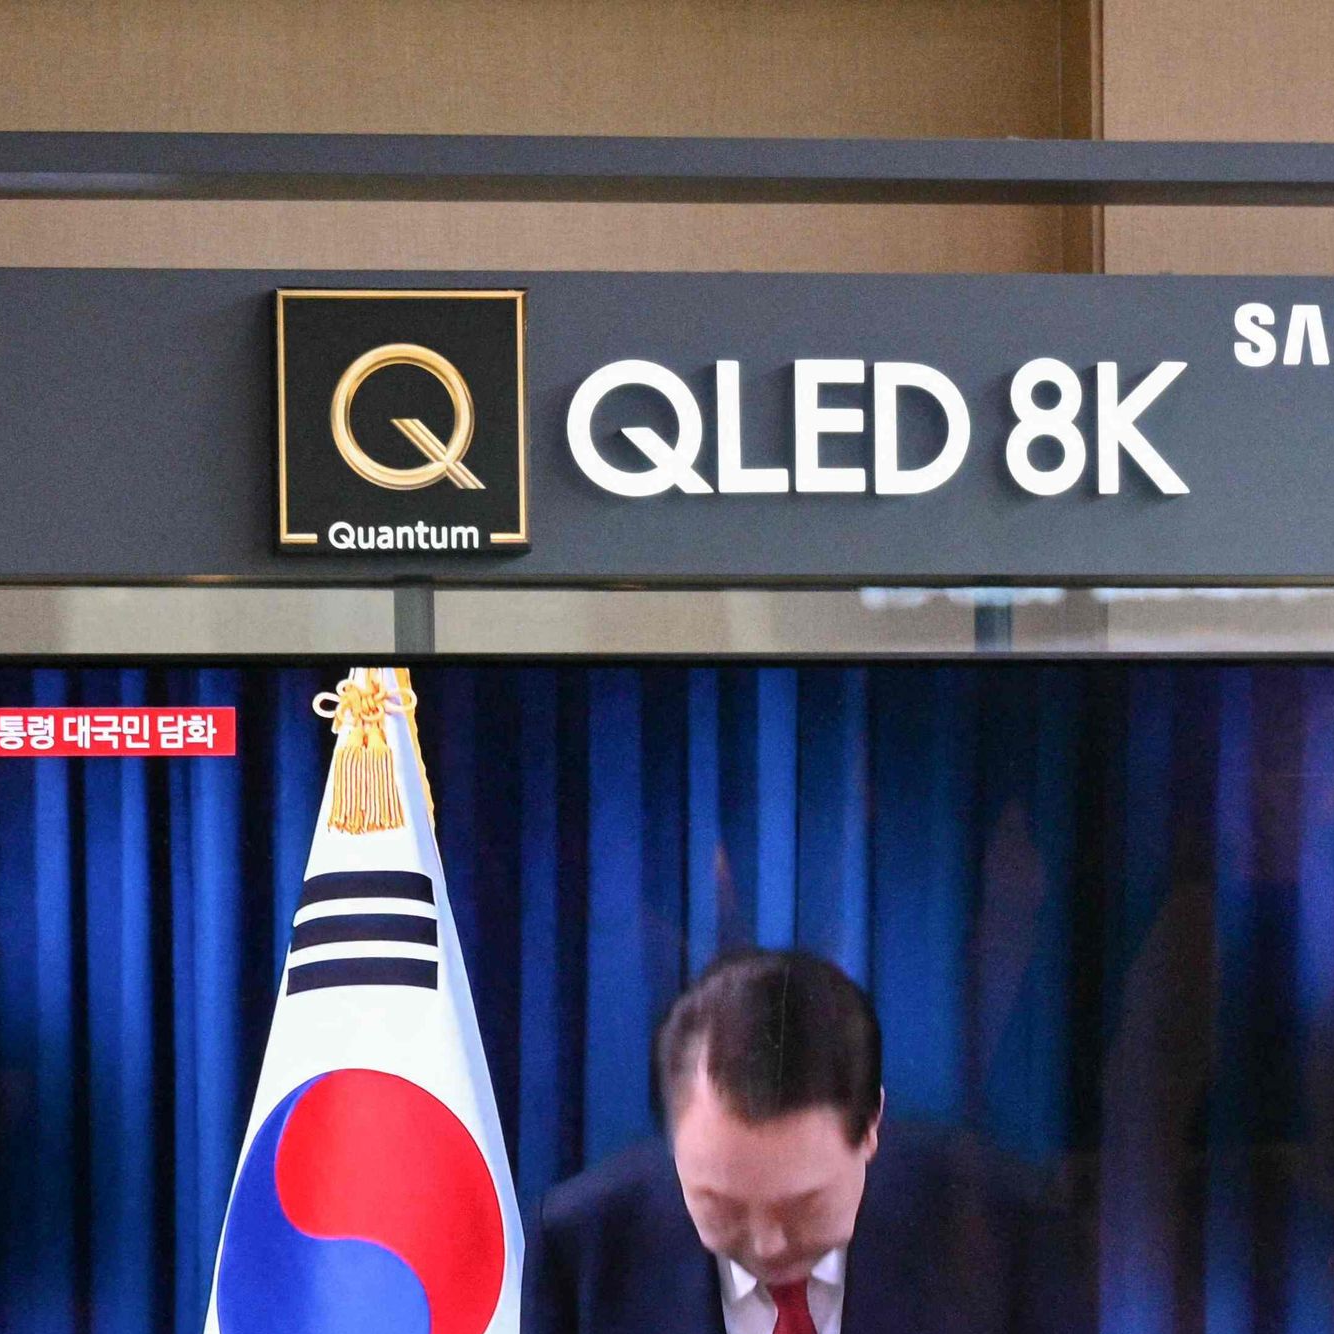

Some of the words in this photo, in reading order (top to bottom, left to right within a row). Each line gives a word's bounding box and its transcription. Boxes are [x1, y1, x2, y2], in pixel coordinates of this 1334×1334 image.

[331, 342, 486, 491] Q
[566, 358, 971, 498] QLED
[1005, 356, 1191, 498] 8K
[327, 520, 479, 550] Quantum
[63, 714, 150, 750] 대국민
[157, 714, 217, 750] 담화
